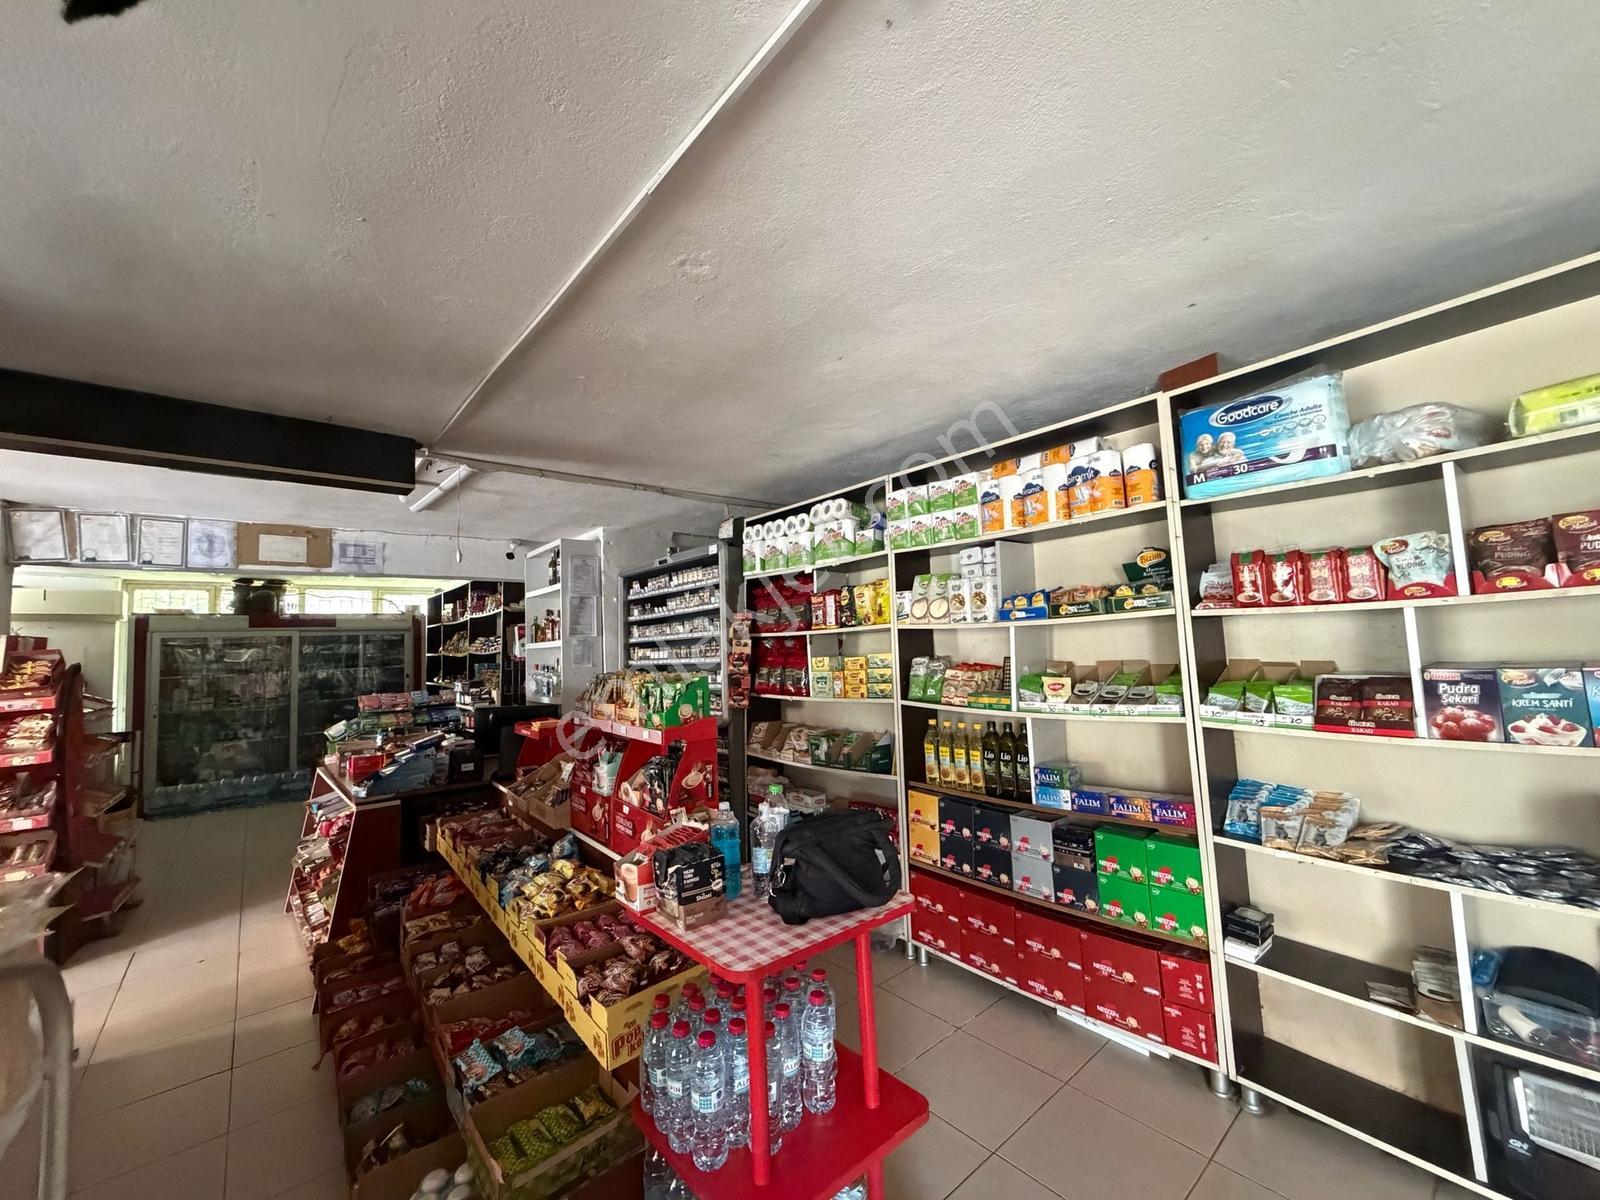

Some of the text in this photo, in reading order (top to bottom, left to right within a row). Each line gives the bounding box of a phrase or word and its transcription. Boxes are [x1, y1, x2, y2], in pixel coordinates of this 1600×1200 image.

[1216, 400, 1279, 424] Goodcare
[1233, 464, 1248, 474] 30
[1193, 473, 1206, 484] M
[1439, 682, 1479, 694] Pudra
[1442, 694, 1478, 705] Şekeri
[1511, 699, 1540, 708] KREM
[984, 750, 995, 759] Lio
[1000, 752, 1011, 761] Lio
[1017, 754, 1029, 763] Lio
[1037, 772, 1061, 783] FALIM
[1074, 797, 1101, 808] FALIM
[1112, 802, 1142, 813] FALIM
[1155, 808, 1187, 819] FALIM
